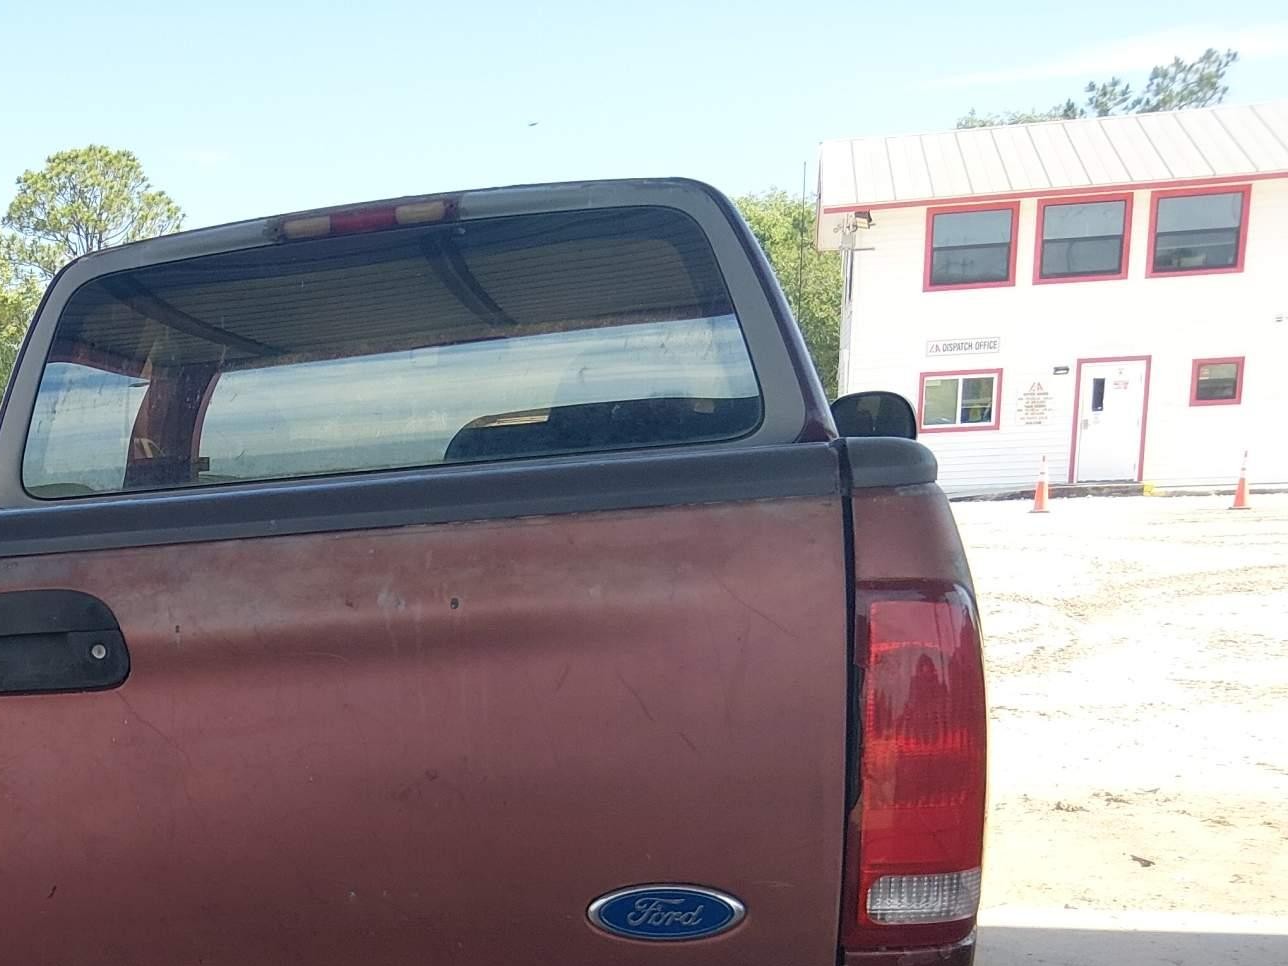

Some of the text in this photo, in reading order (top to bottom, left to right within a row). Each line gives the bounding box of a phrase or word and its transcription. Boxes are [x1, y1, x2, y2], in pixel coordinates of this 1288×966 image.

[942, 341, 973, 353] DISPATCH
[974, 340, 998, 351] OFFICE
[626, 897, 704, 926] Ford
